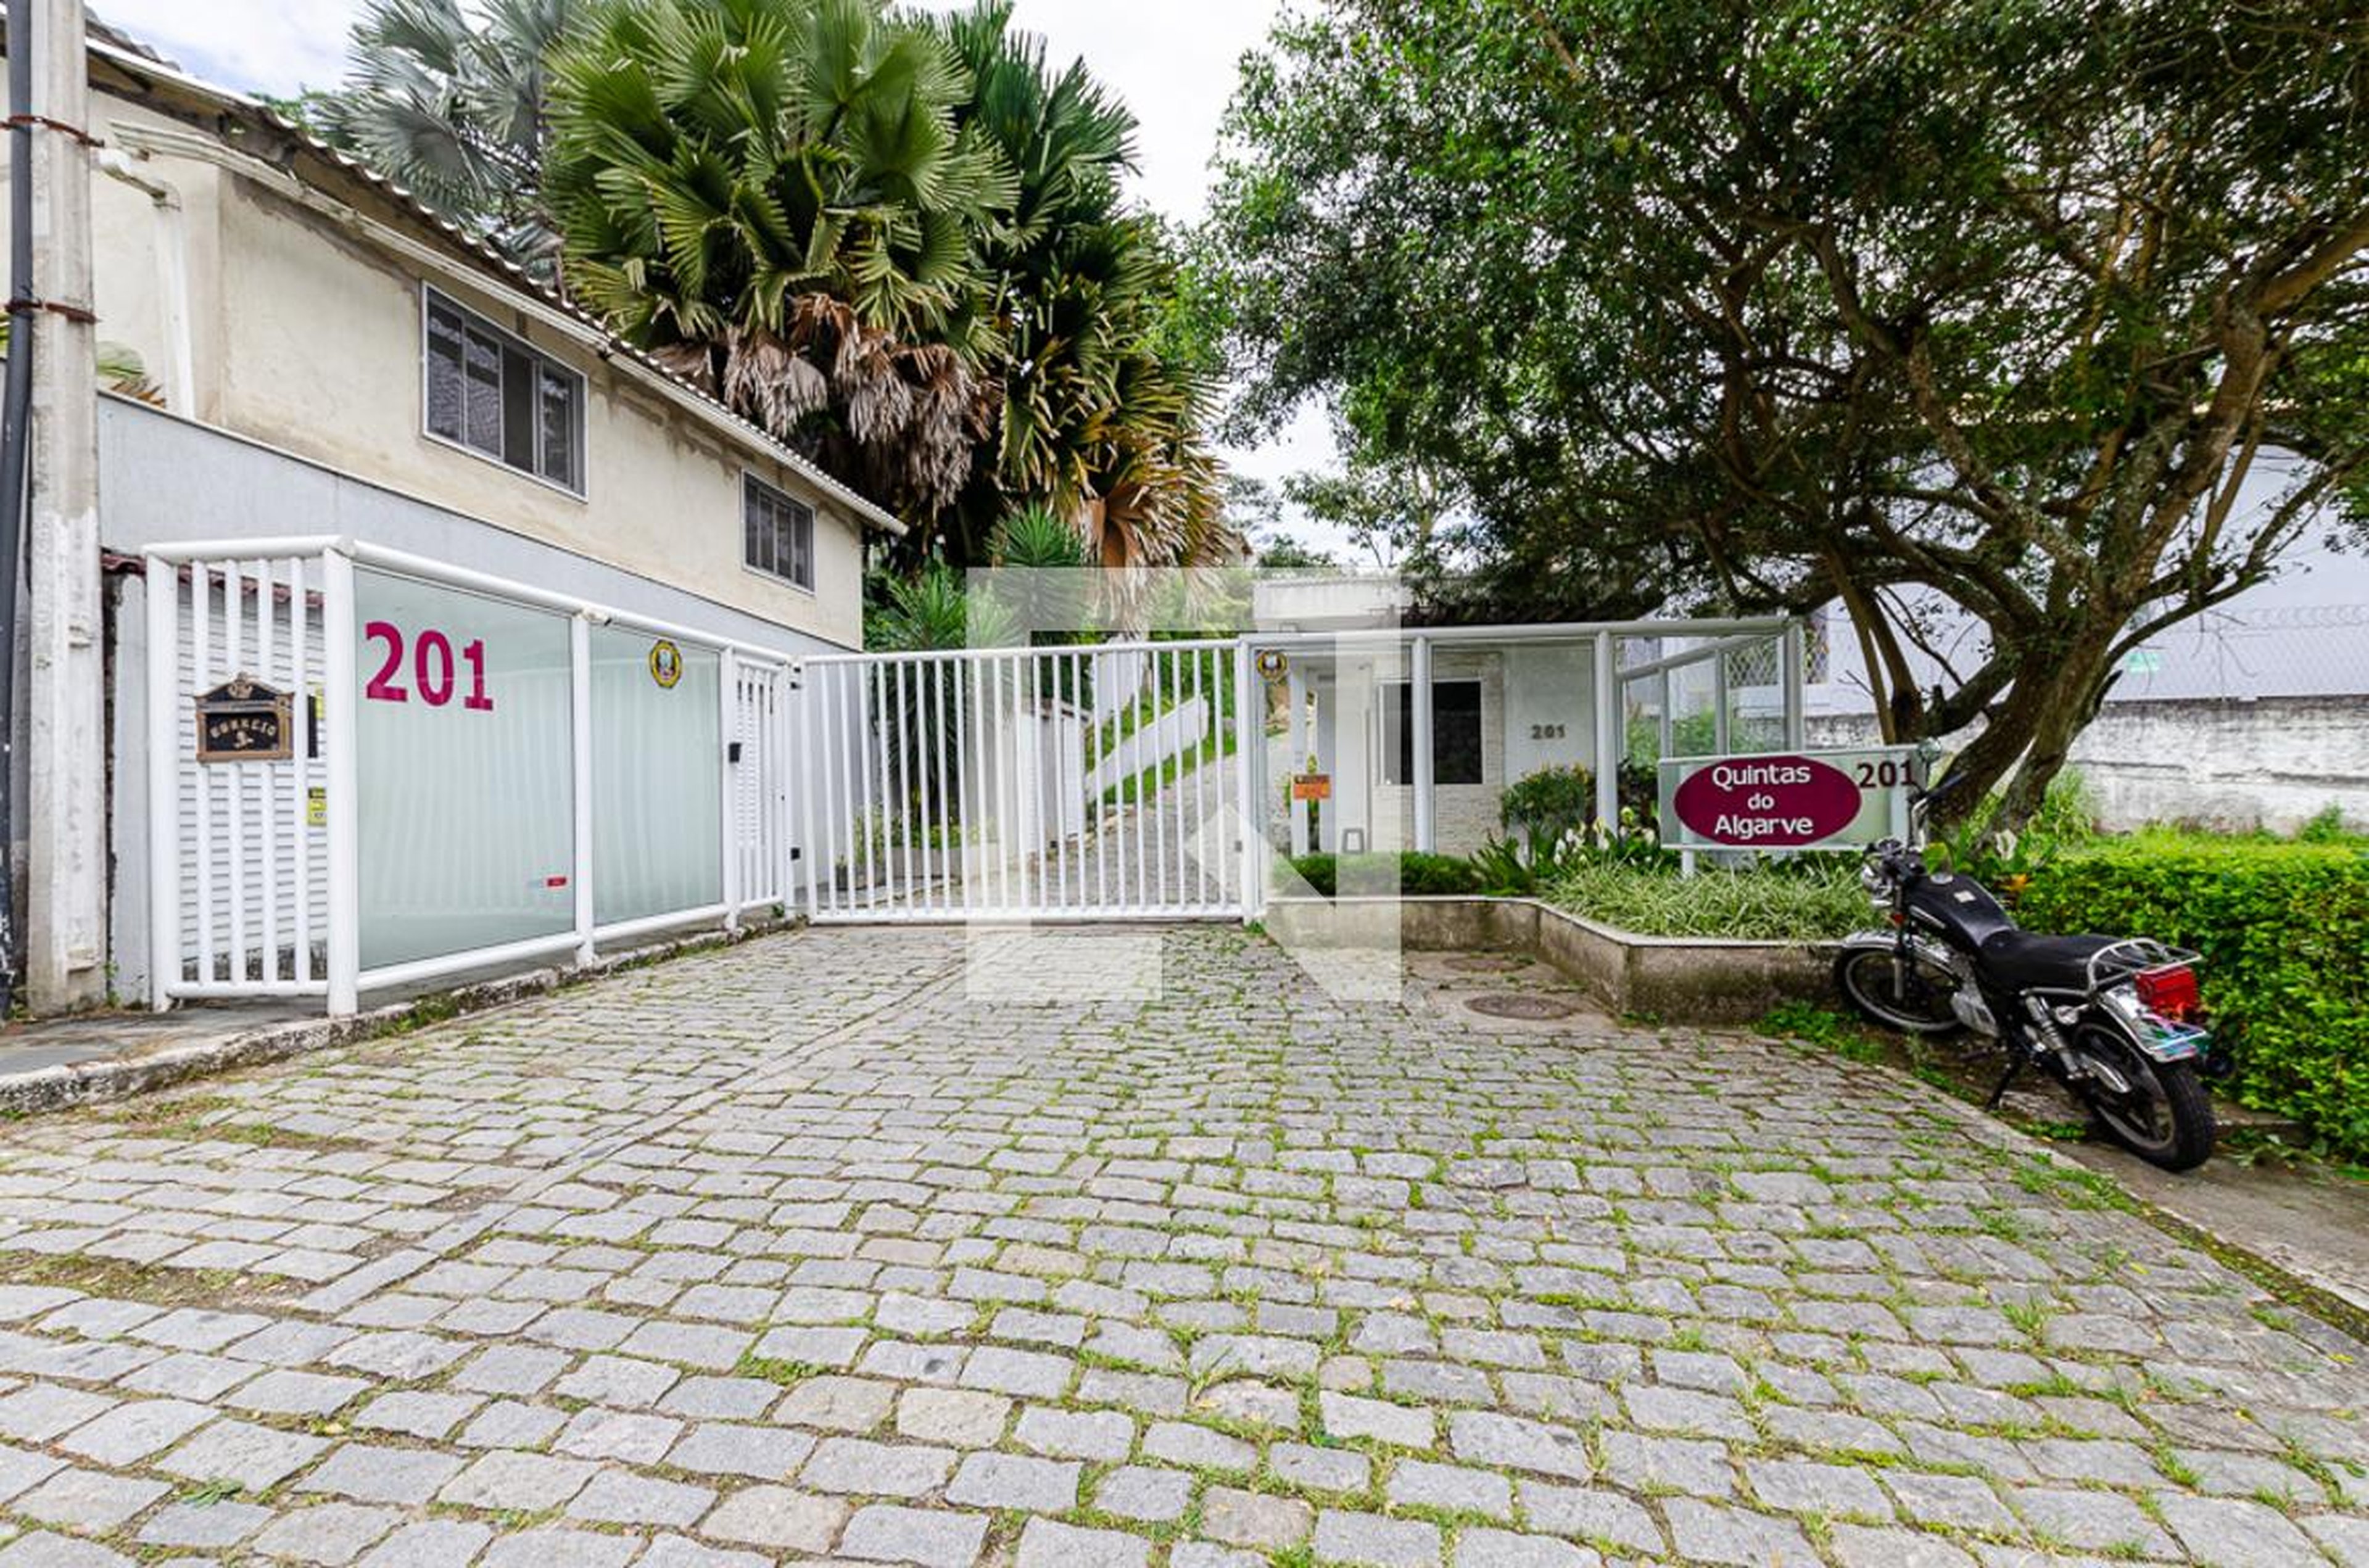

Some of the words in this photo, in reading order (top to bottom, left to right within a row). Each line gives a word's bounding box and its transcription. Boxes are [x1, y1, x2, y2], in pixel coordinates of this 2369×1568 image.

[366, 621, 493, 711] 201
[1531, 724, 1566, 740] 201
[1712, 764, 1811, 791] Quintas
[1857, 759, 1914, 788] 201
[1747, 793, 1775, 810] do
[1714, 814, 1814, 840] Algarve
